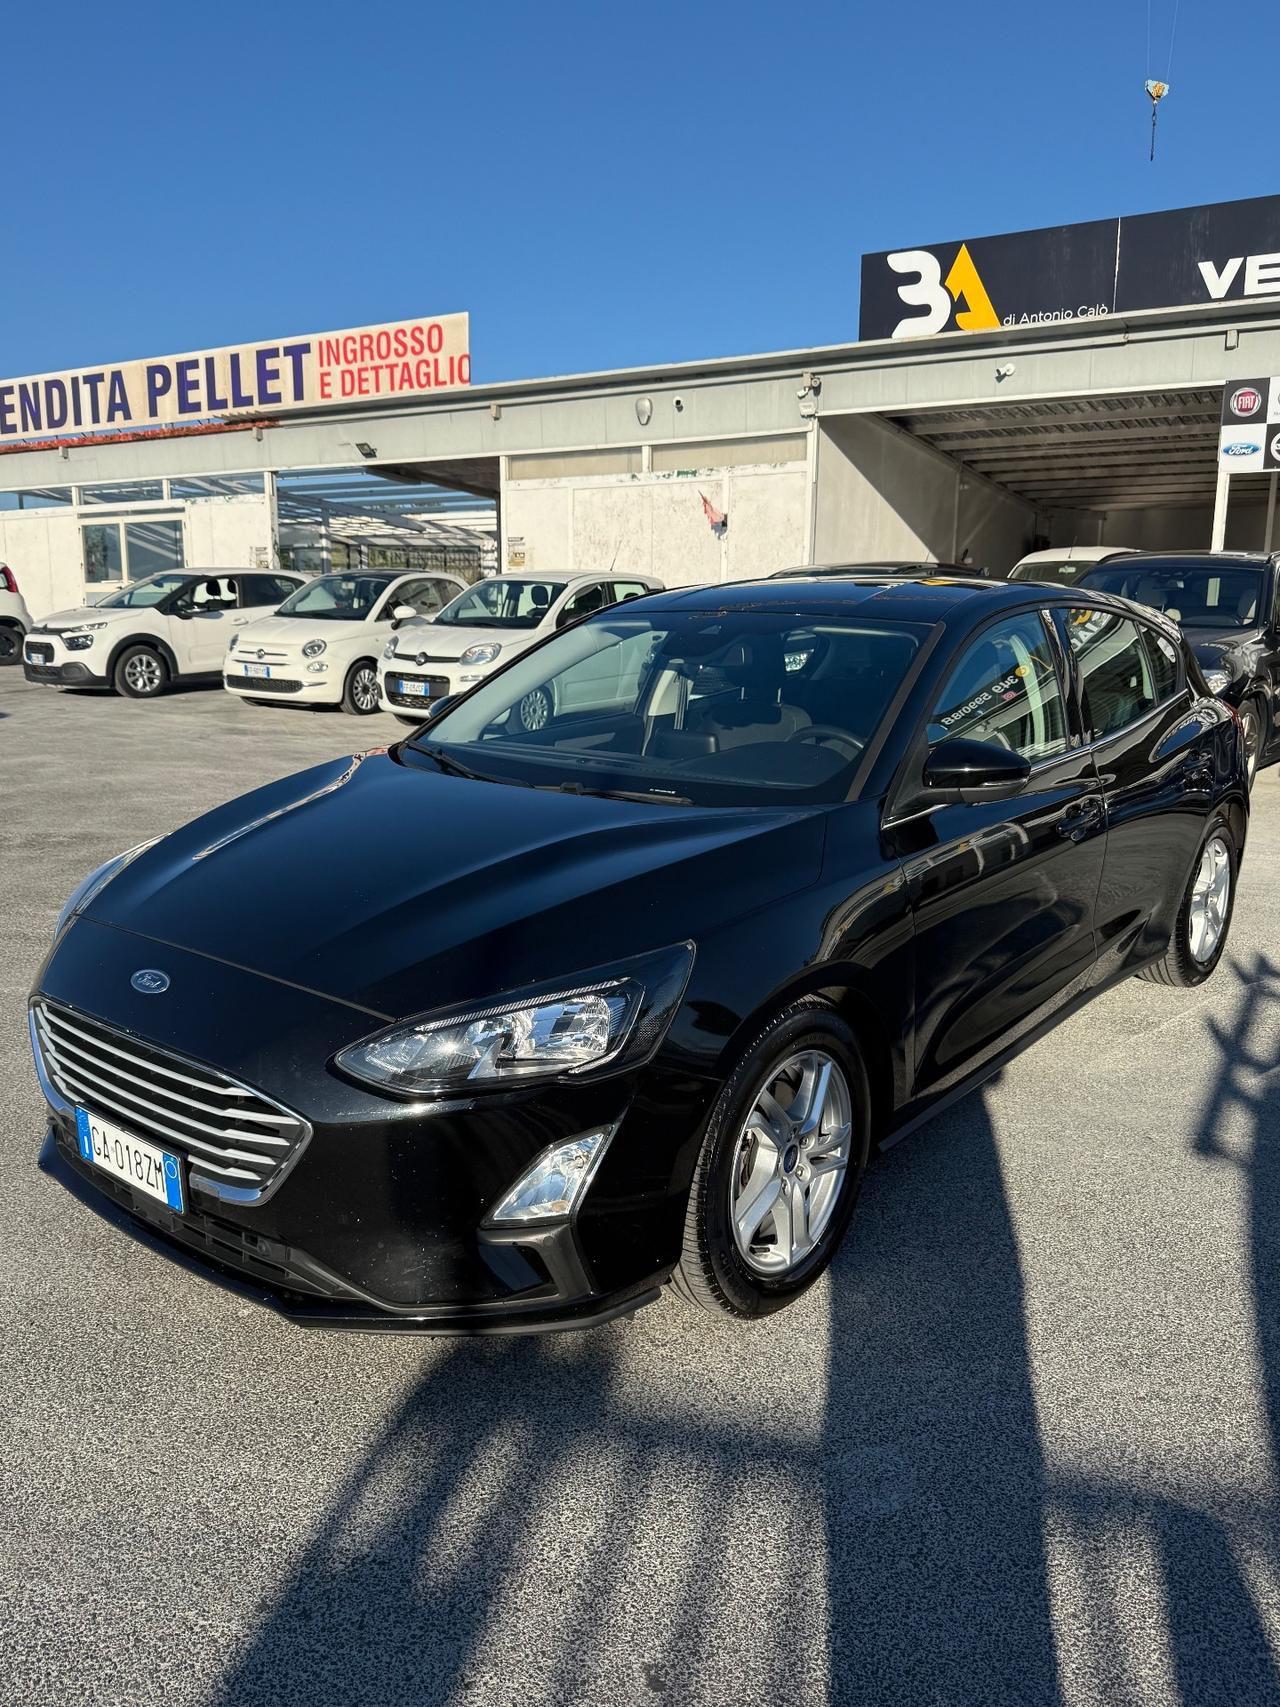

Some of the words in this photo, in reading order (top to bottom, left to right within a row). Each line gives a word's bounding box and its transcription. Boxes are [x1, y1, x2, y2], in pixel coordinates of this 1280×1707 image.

[1003, 313, 1015, 326] di
[1019, 308, 1073, 325] Antonio
[1077, 303, 1109, 318] Calò
[318, 323, 444, 368] INGROSSO
[0, 370, 132, 434] ENDITA
[146, 342, 311, 418] PELLET
[320, 371, 332, 399] E
[340, 353, 471, 397] DETTAGLIO
[1237, 395, 1256, 410] FIAT
[1228, 442, 1254, 455] Ford
